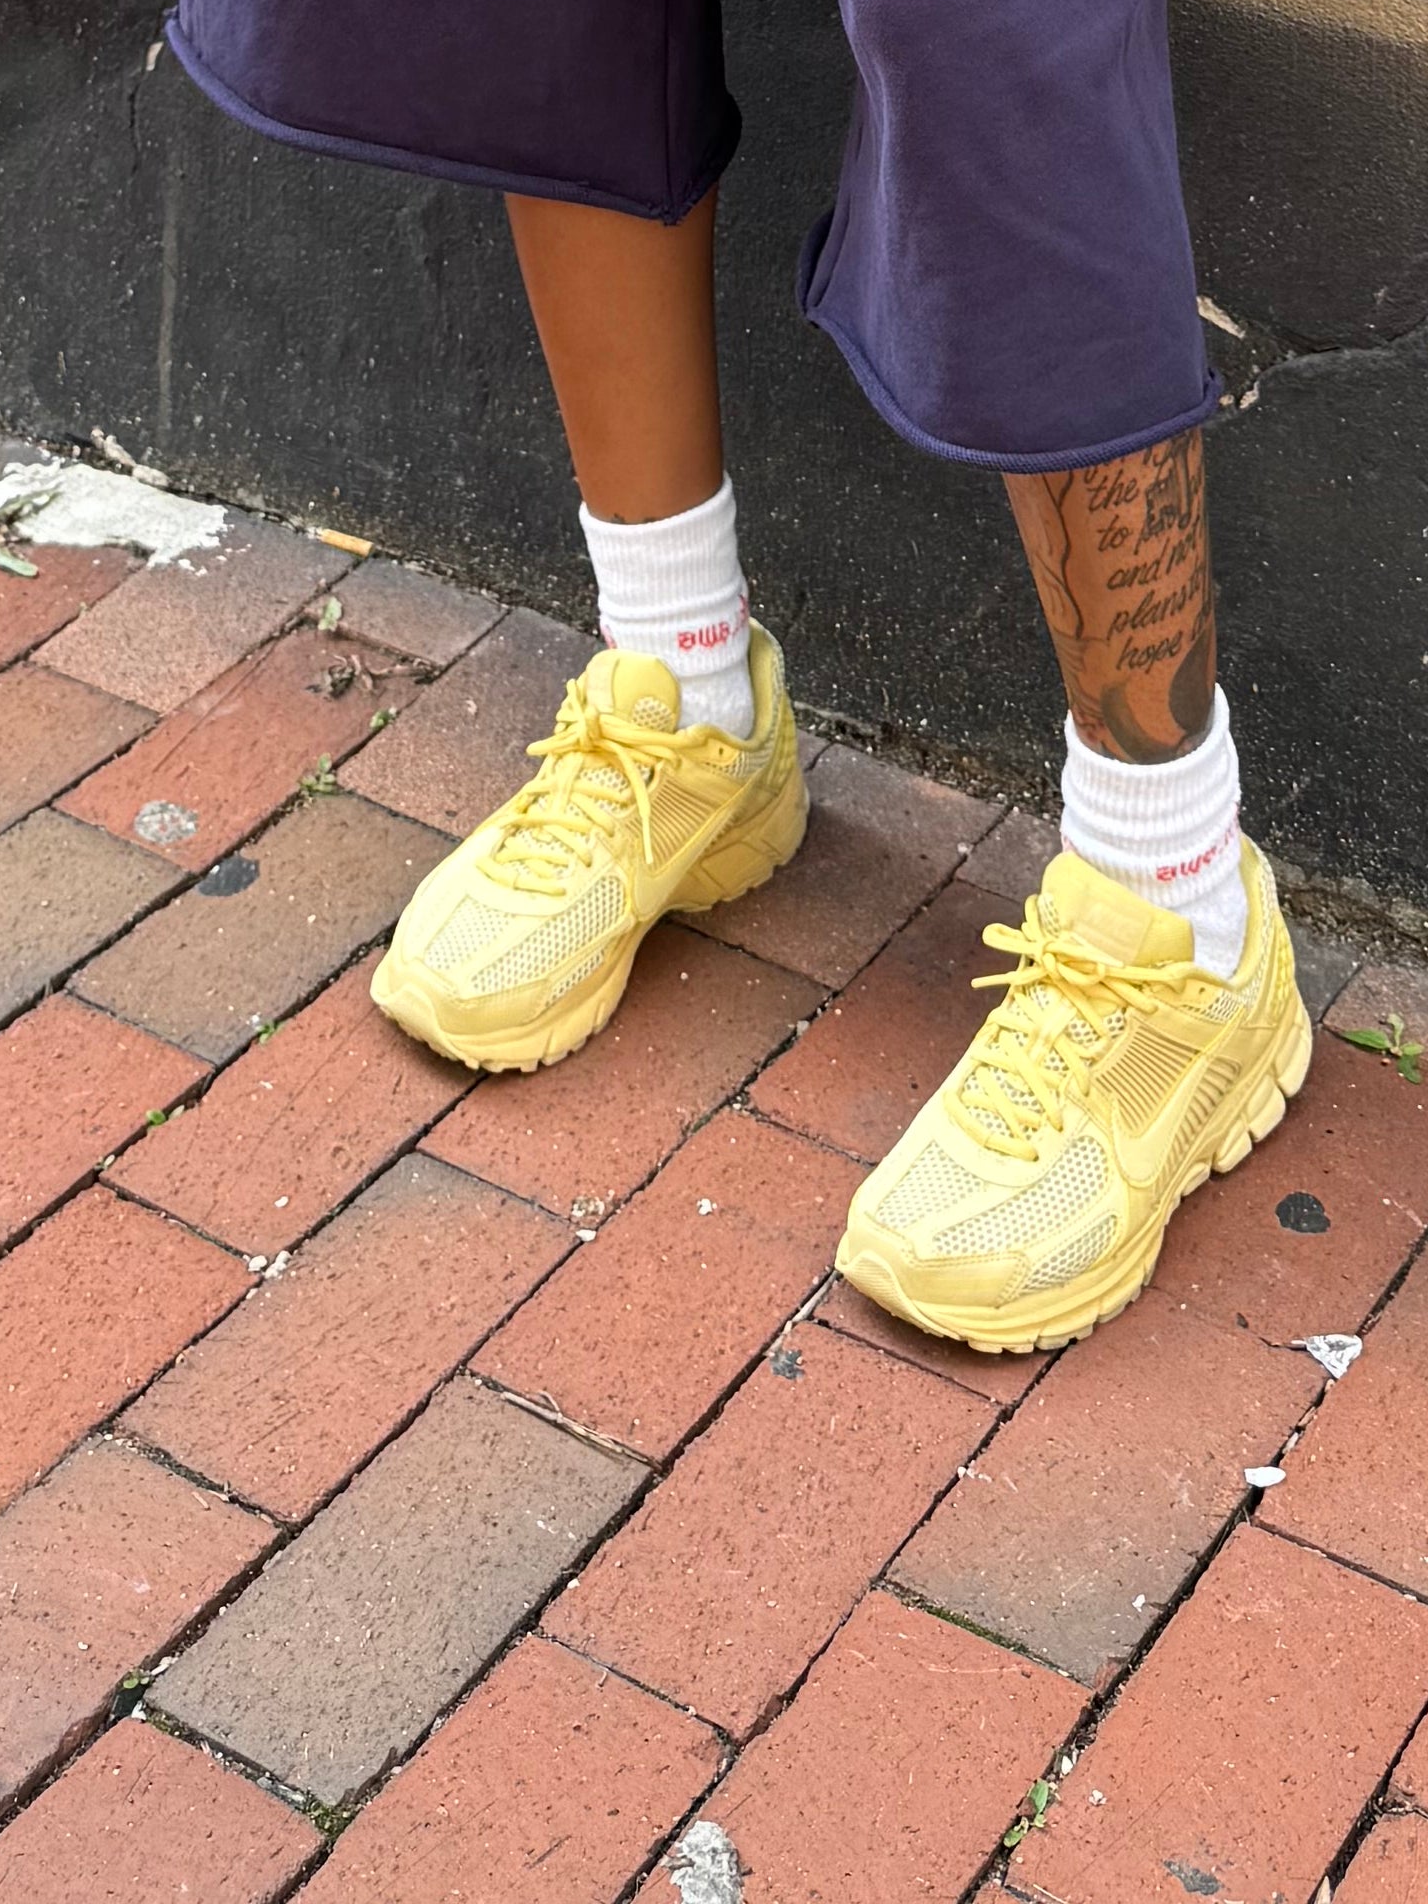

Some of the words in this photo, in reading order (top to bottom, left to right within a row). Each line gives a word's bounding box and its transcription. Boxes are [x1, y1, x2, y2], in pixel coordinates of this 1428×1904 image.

[1088, 469, 1141, 512] the
[1097, 514, 1134, 552] to
[1107, 537, 1170, 591] and
[1116, 630, 1184, 675] hope
